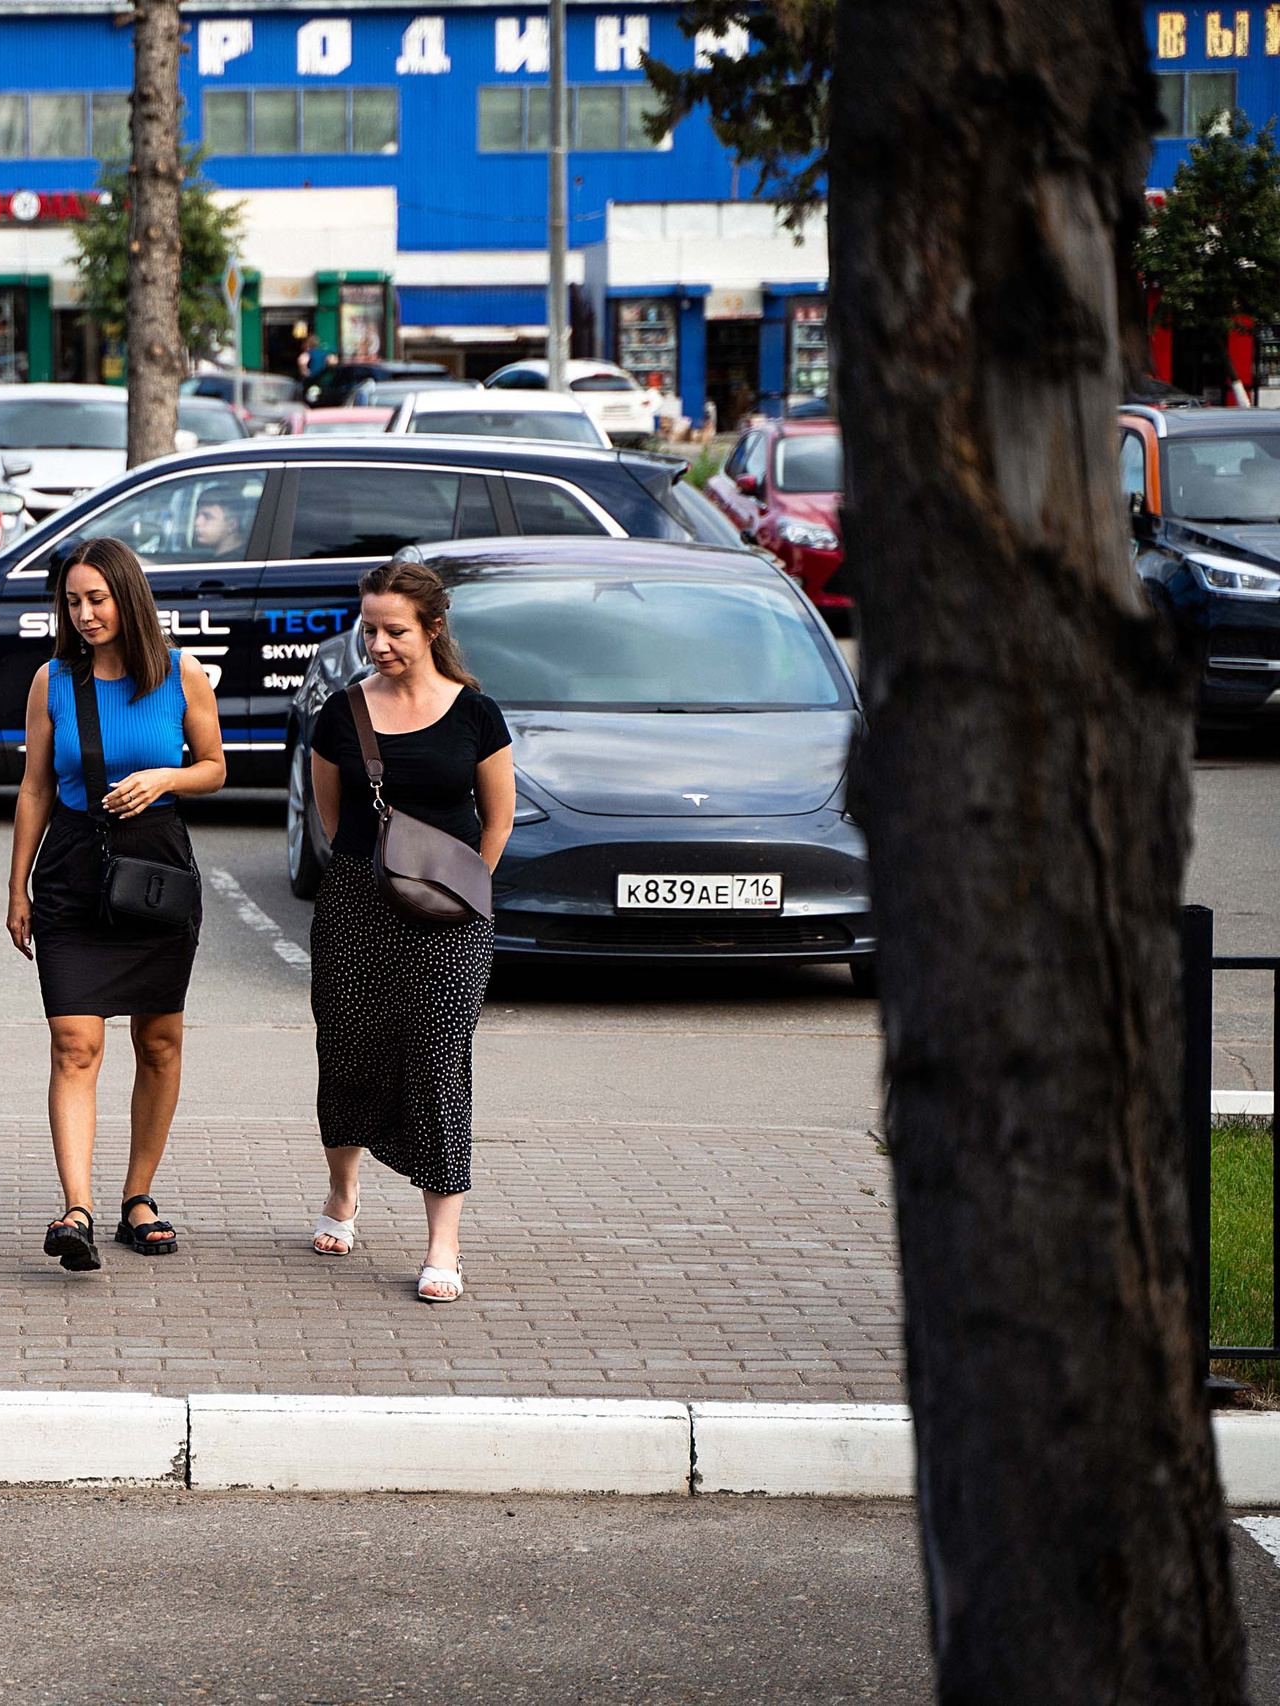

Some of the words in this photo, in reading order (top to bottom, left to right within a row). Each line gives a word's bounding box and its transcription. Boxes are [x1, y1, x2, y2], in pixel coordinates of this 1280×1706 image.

[627, 879, 729, 904] К839АЕ
[735, 878, 773, 898] 716
[744, 897, 763, 906] RUS
